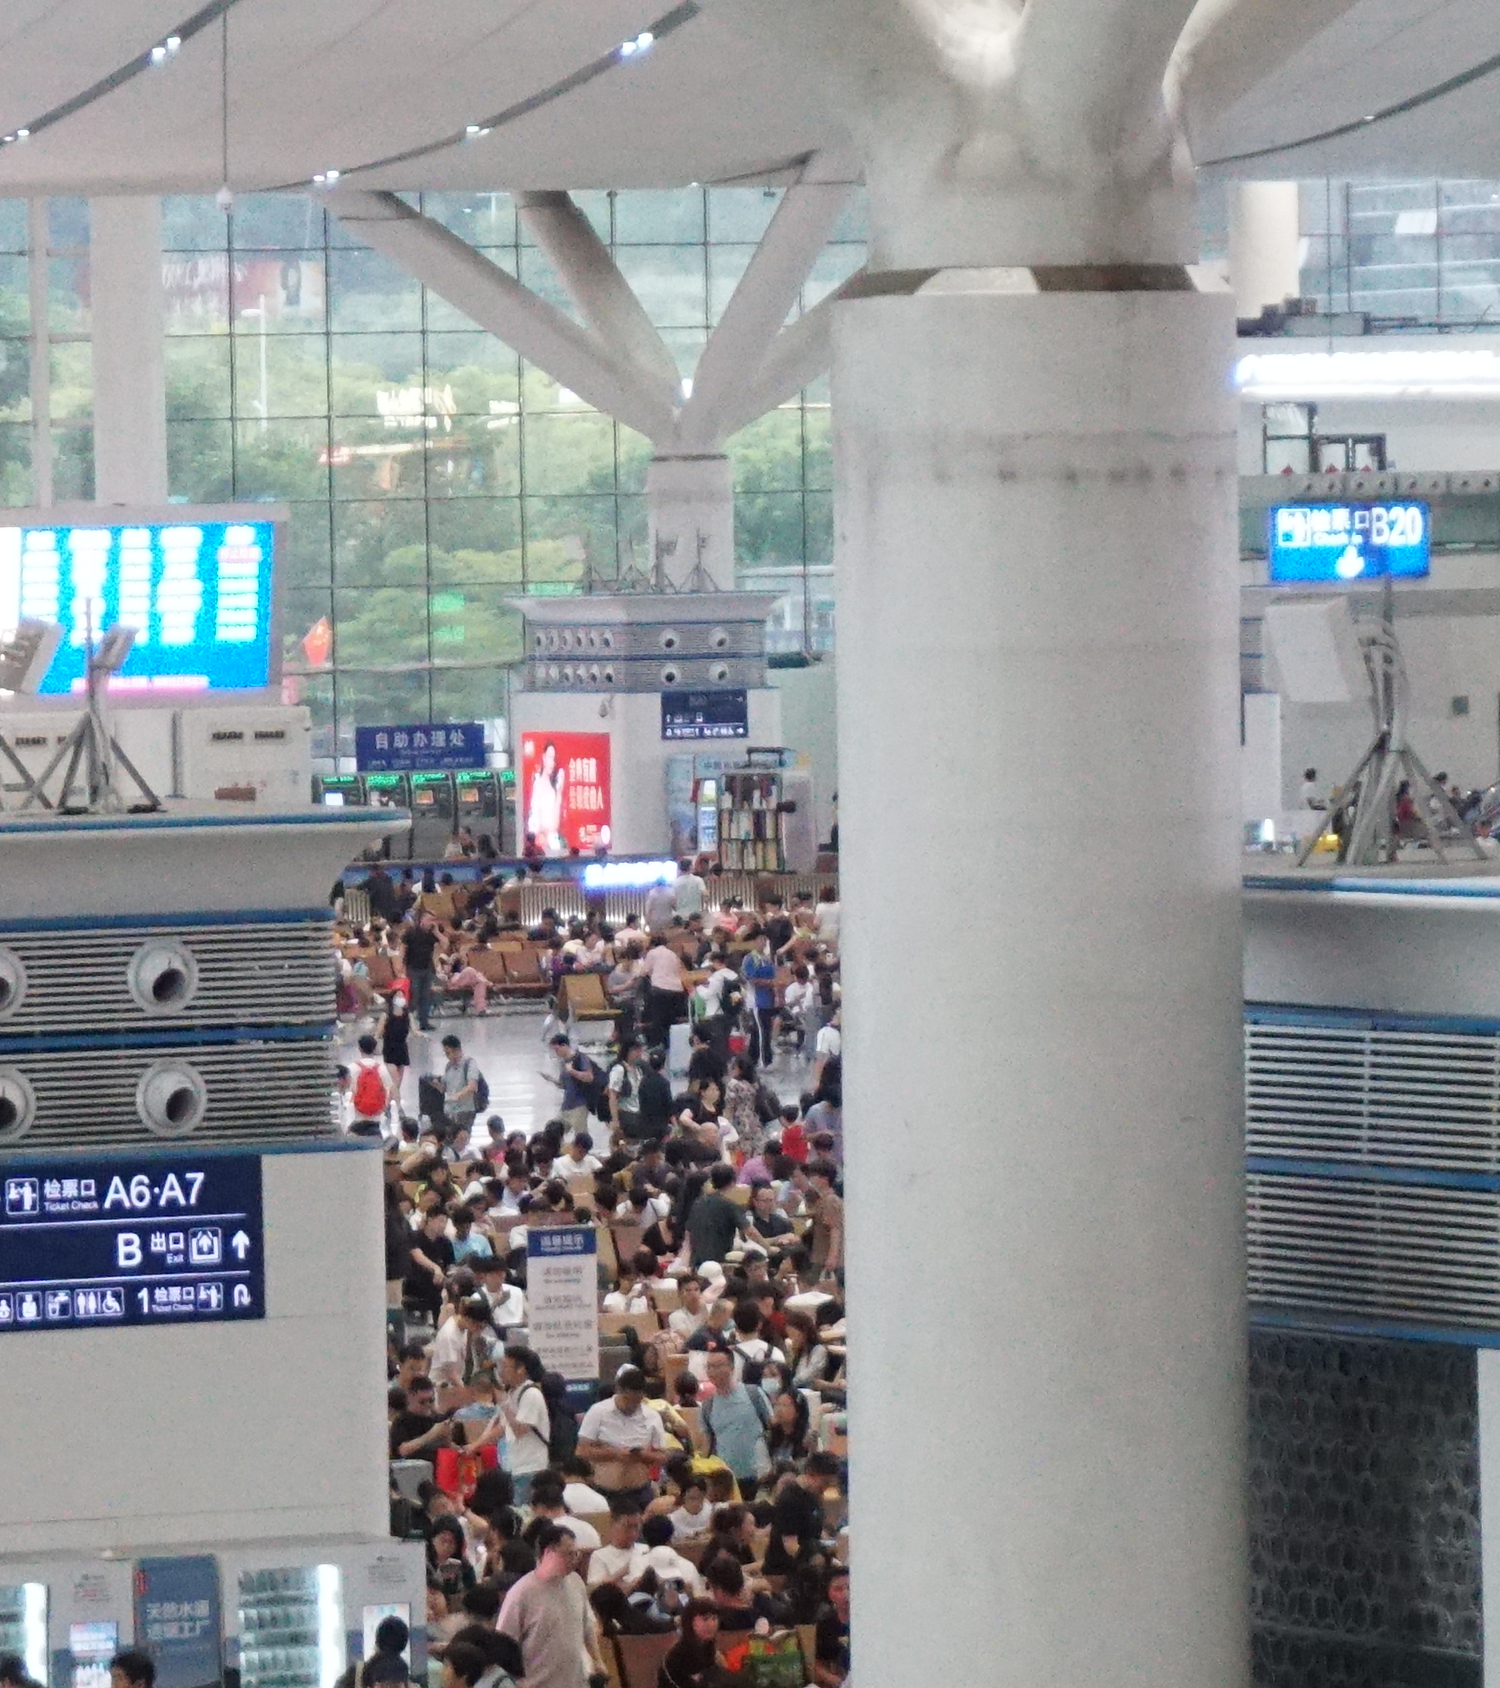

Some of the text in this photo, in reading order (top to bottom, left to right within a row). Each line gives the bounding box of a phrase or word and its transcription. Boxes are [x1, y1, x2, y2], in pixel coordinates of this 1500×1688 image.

[1371, 506, 1423, 545] B20
[375, 729, 465, 750] 自助办理处
[43, 1171, 205, 1209] 检票口 A6·A7
[44, 1200, 99, 1211] Ticket Check
[117, 1231, 184, 1268] B 出口
[166, 1253, 184, 1265] Exit
[137, 1286, 195, 1314] 1 检票口
